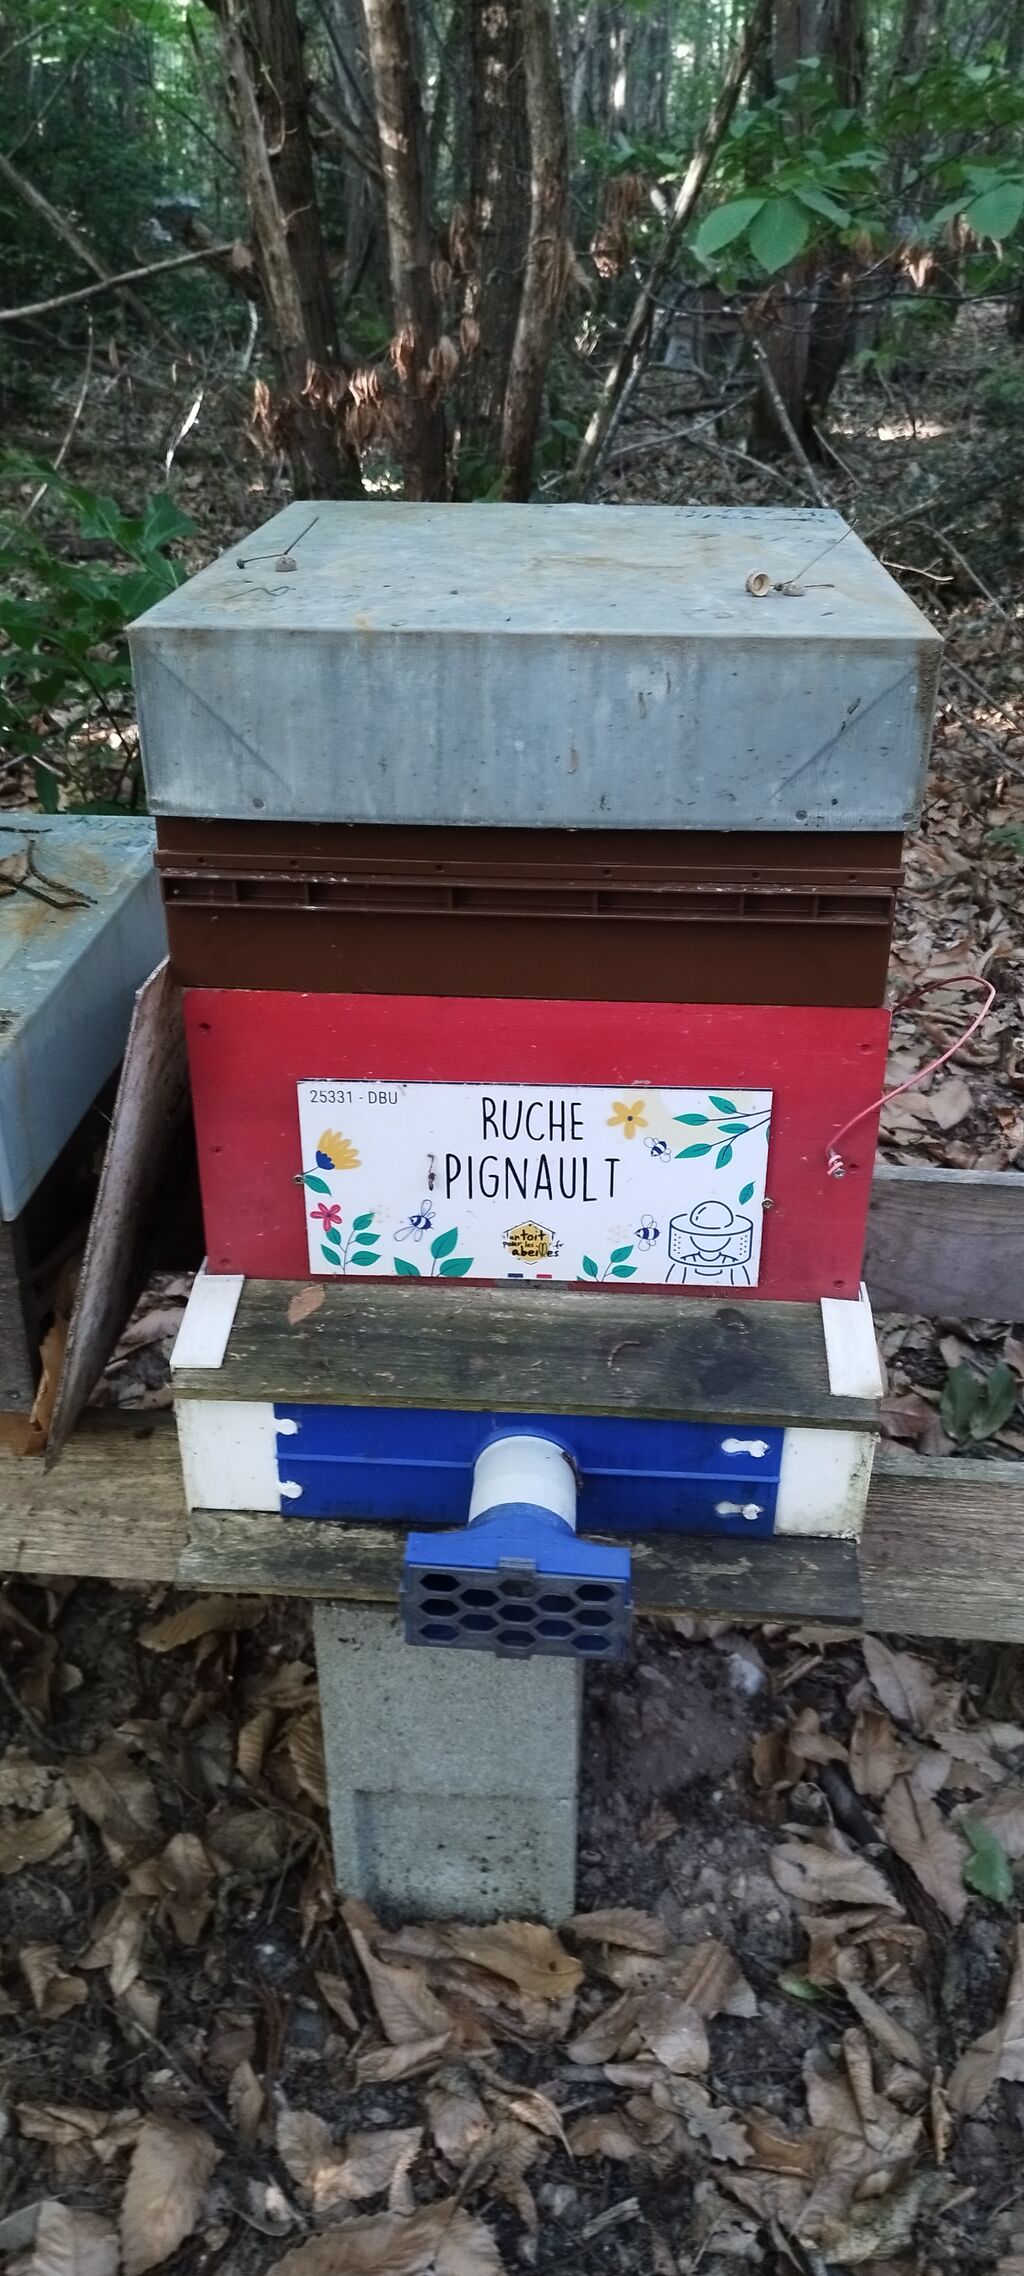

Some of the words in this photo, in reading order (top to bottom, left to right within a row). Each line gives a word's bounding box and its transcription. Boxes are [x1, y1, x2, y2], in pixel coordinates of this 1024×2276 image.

[309, 1089, 352, 1104] 25331
[368, 1091, 398, 1105] DBU
[482, 1096, 584, 1142] RUCHE
[446, 1153, 621, 1202] PIGNAULT
[520, 1229, 546, 1241] toit
